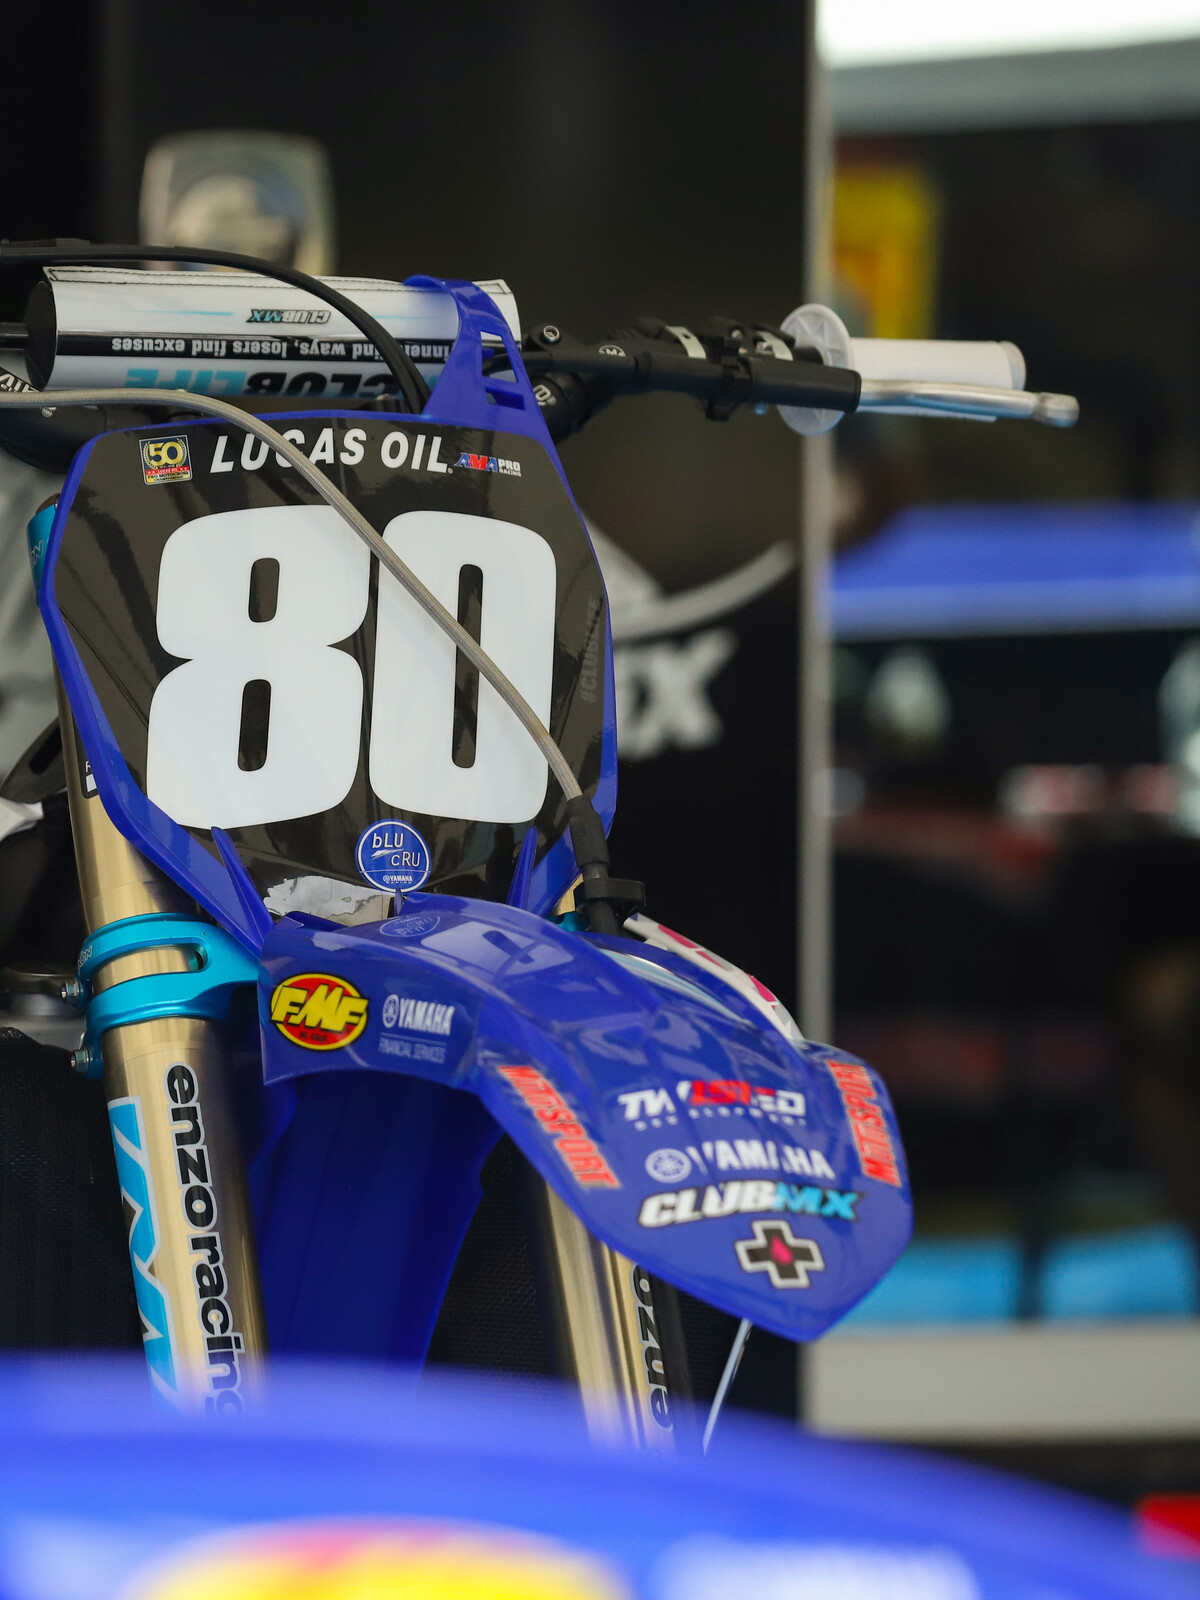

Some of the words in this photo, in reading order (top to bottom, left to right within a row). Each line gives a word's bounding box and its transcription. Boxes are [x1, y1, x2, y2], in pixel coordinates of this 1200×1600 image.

[246, 309, 331, 325] CLUBMX
[111, 337, 186, 352] excuses
[191, 338, 227, 357] find
[233, 340, 288, 358] losers
[294, 338, 346, 356] ways,
[352, 342, 384, 361] ind
[400, 343, 453, 361] inner
[125, 368, 436, 398] CLUBLIFE
[149, 441, 183, 467] 50
[210, 428, 367, 473] LUCAS
[380, 431, 448, 474] OIL
[454, 452, 498, 472] AMA
[498, 458, 521, 471] PRO
[146, 504, 557, 828] 80
[372, 832, 404, 849] bLU
[390, 851, 421, 867] cRU
[271, 984, 369, 1033] FMF
[398, 997, 456, 1036] YAMAHA
[639, 1180, 861, 1228] CLUBMX
